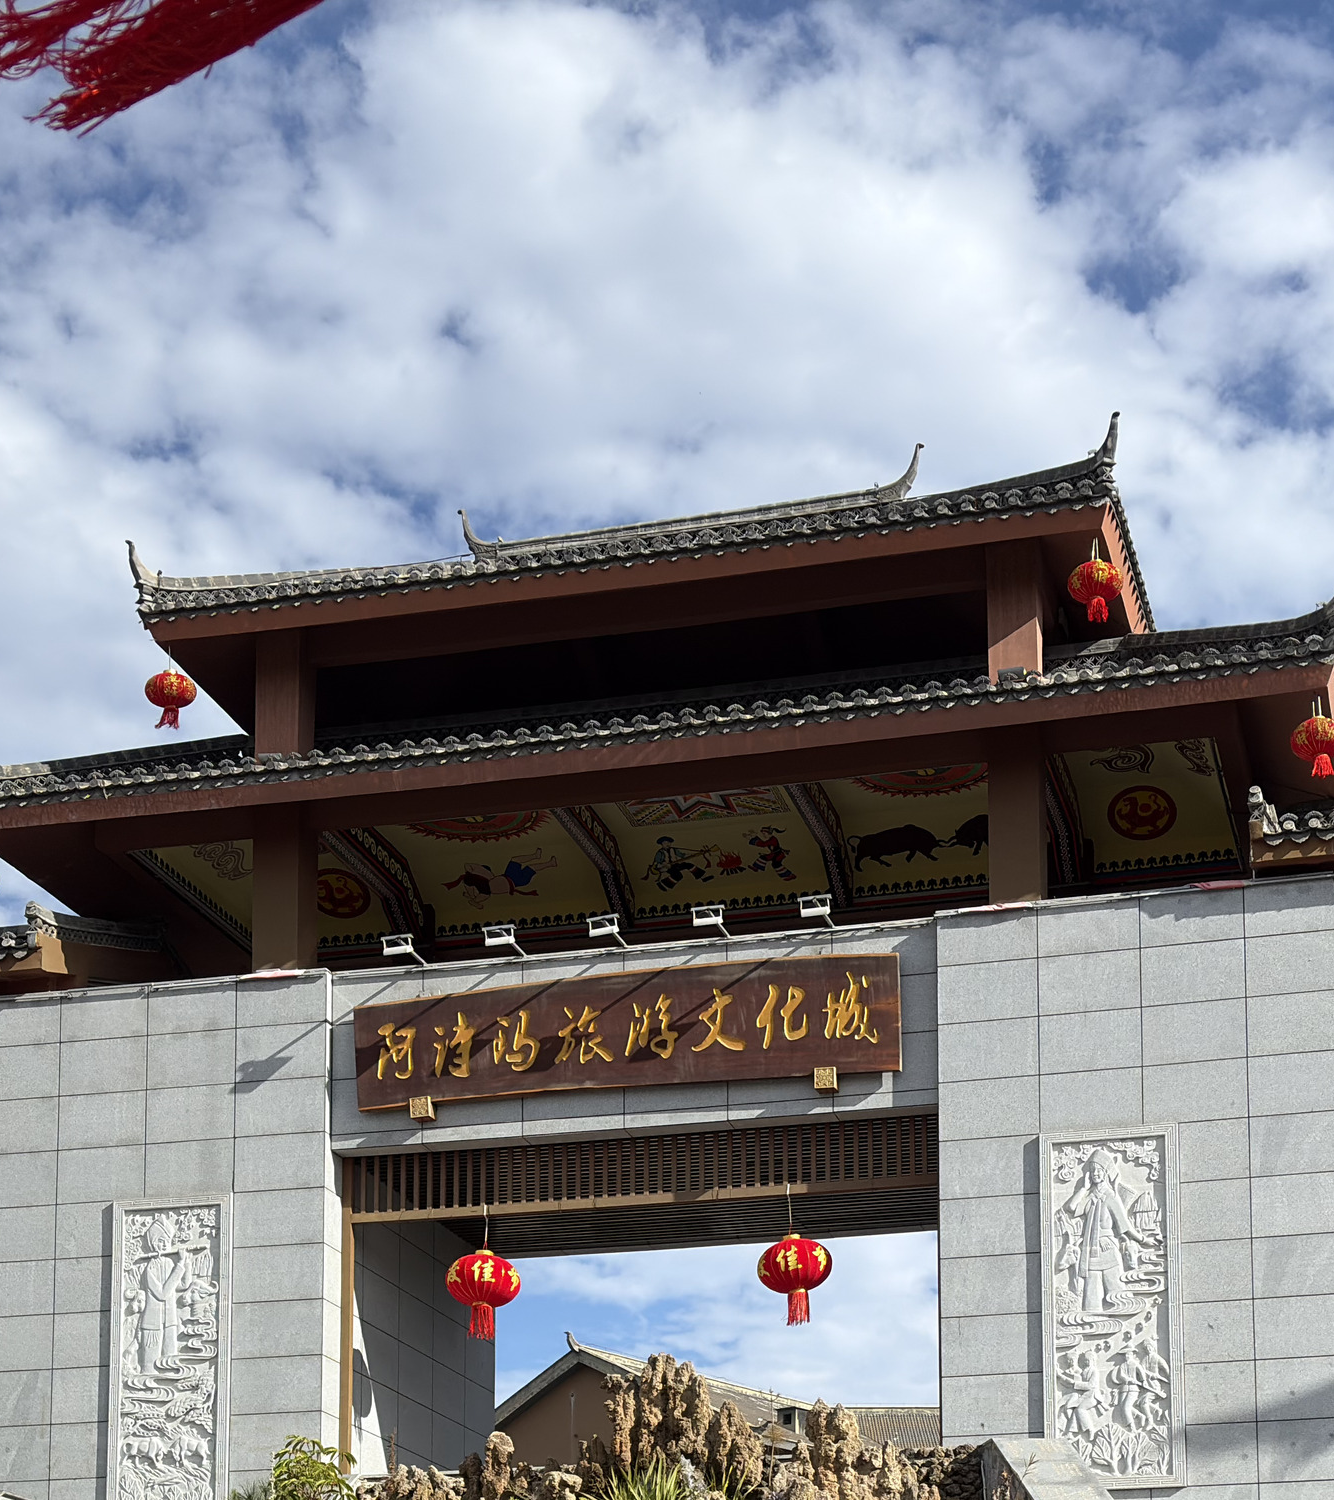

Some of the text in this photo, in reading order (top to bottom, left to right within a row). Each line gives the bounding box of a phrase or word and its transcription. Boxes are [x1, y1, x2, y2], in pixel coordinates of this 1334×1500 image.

[376, 970, 879, 1081] 阿诗玛旅游文化城
